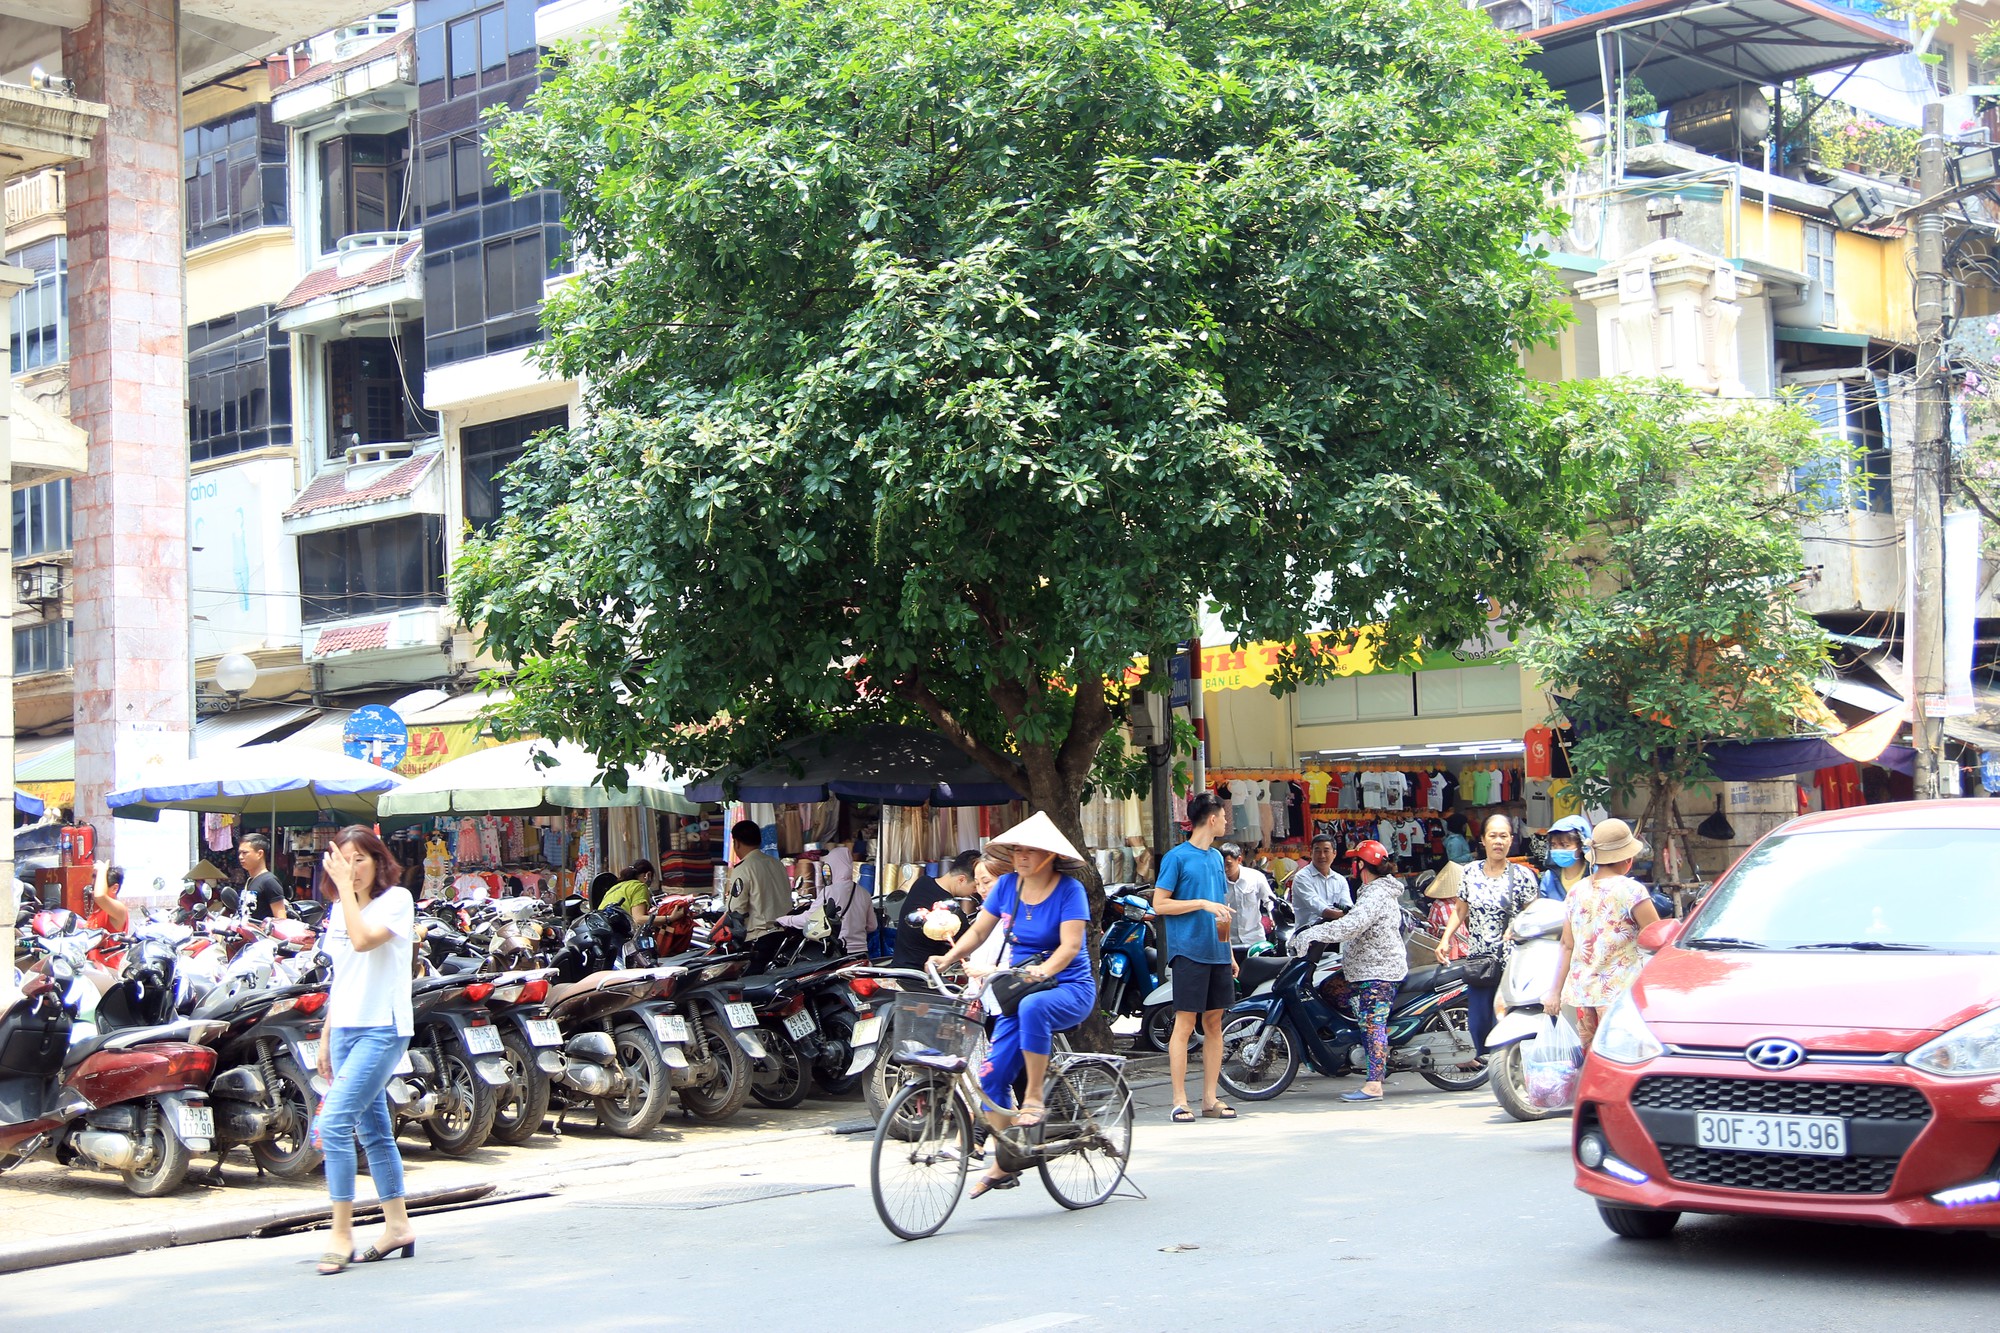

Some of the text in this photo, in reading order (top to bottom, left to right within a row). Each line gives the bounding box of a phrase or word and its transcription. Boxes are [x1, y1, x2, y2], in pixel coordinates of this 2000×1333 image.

[1468, 651, 1487, 661] 093
[793, 1022, 813, 1038] 2689
[1701, 1116, 1840, 1150] 30F-315.96
